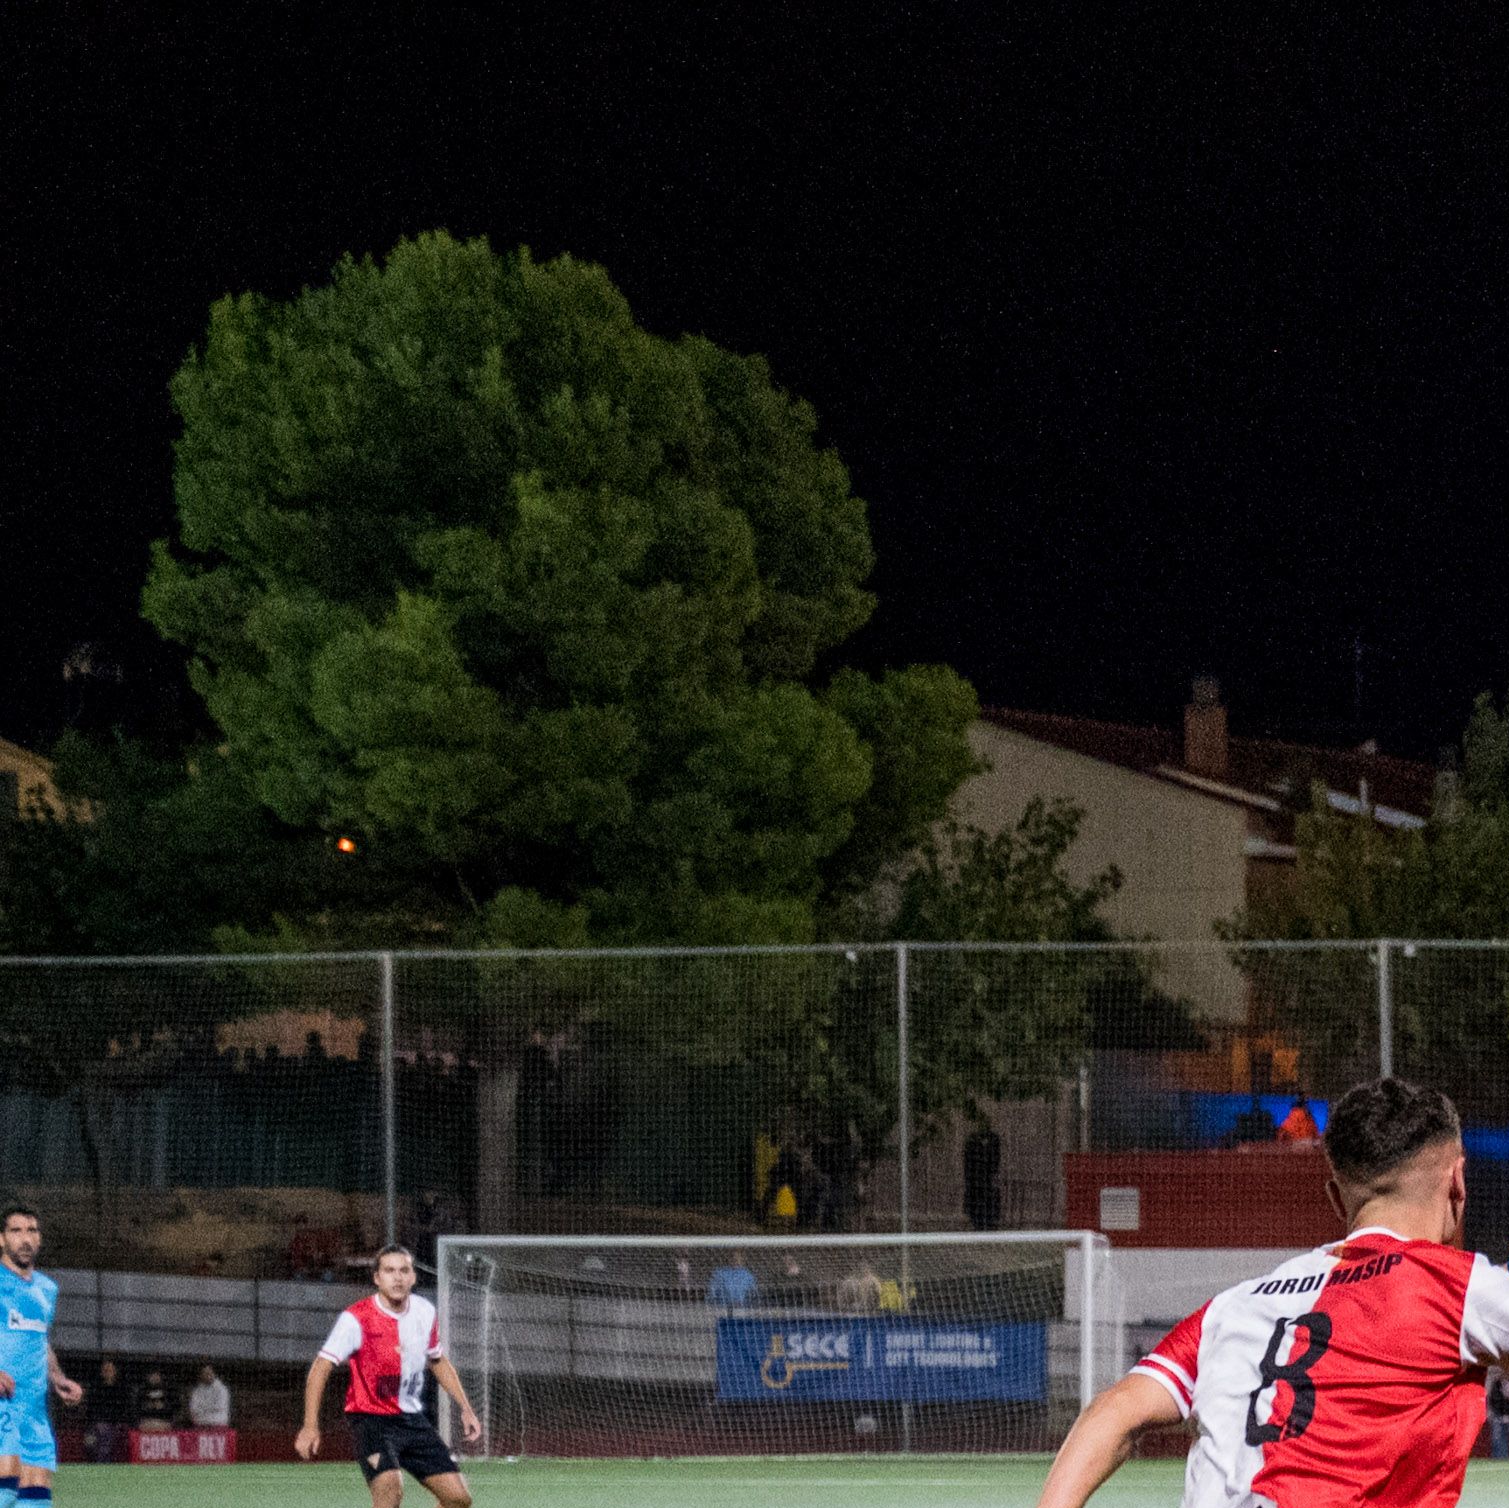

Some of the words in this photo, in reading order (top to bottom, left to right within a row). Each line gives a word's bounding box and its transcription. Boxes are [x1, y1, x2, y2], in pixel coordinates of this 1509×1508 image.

[1251, 1273, 1325, 1295] JORDI
[1325, 1253, 1404, 1288] MASIP
[1245, 1311, 1333, 1448] 8
[140, 1434, 181, 1460] COPA
